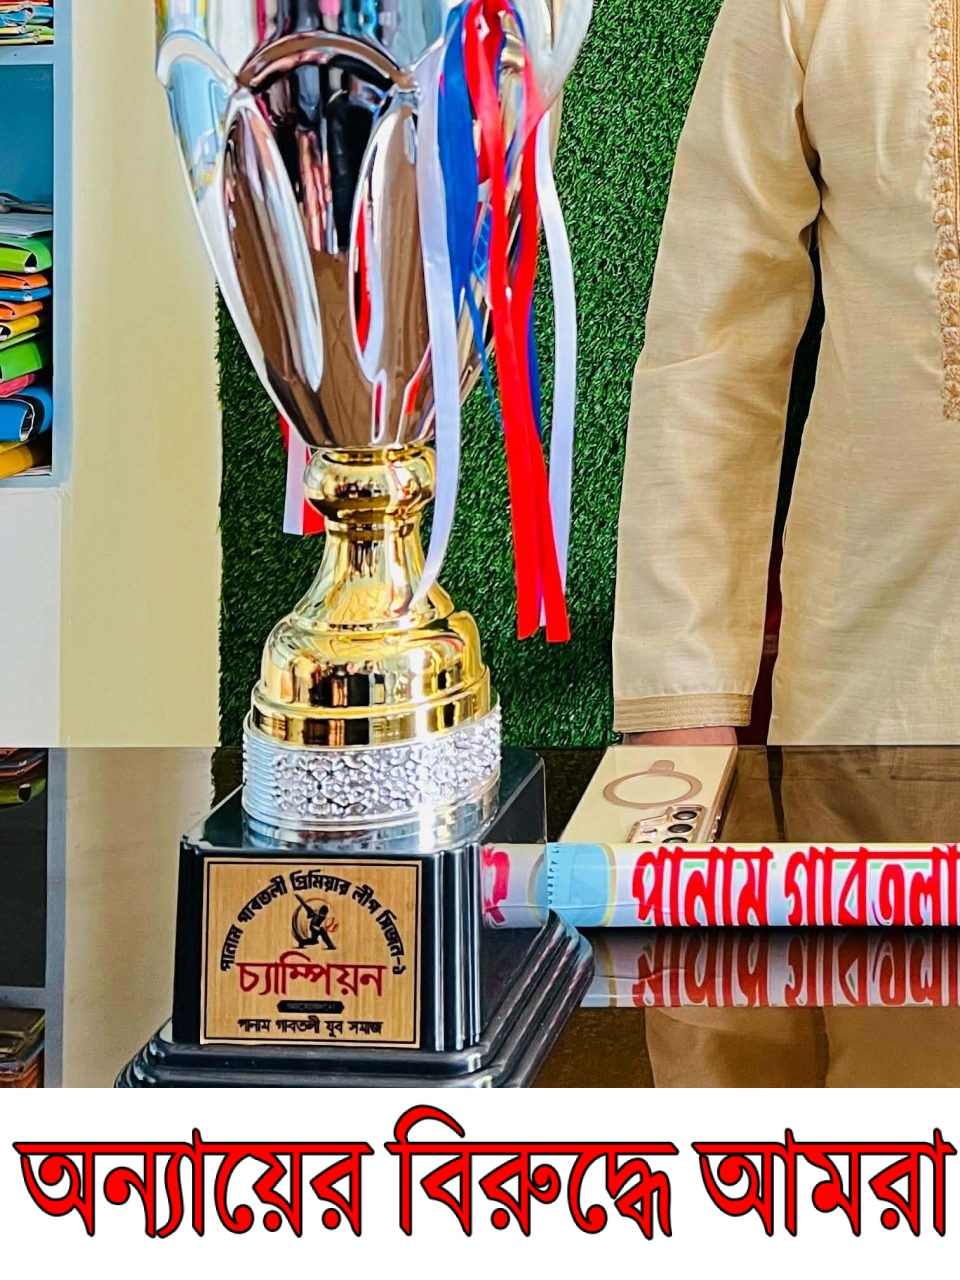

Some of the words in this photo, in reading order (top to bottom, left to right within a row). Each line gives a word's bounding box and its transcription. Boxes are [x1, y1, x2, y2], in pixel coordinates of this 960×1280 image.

[235, 950, 388, 997] চ্যাম্পিয়ন
[324, 1020, 344, 1038] যুব
[347, 1021, 384, 1035] সমাজ
